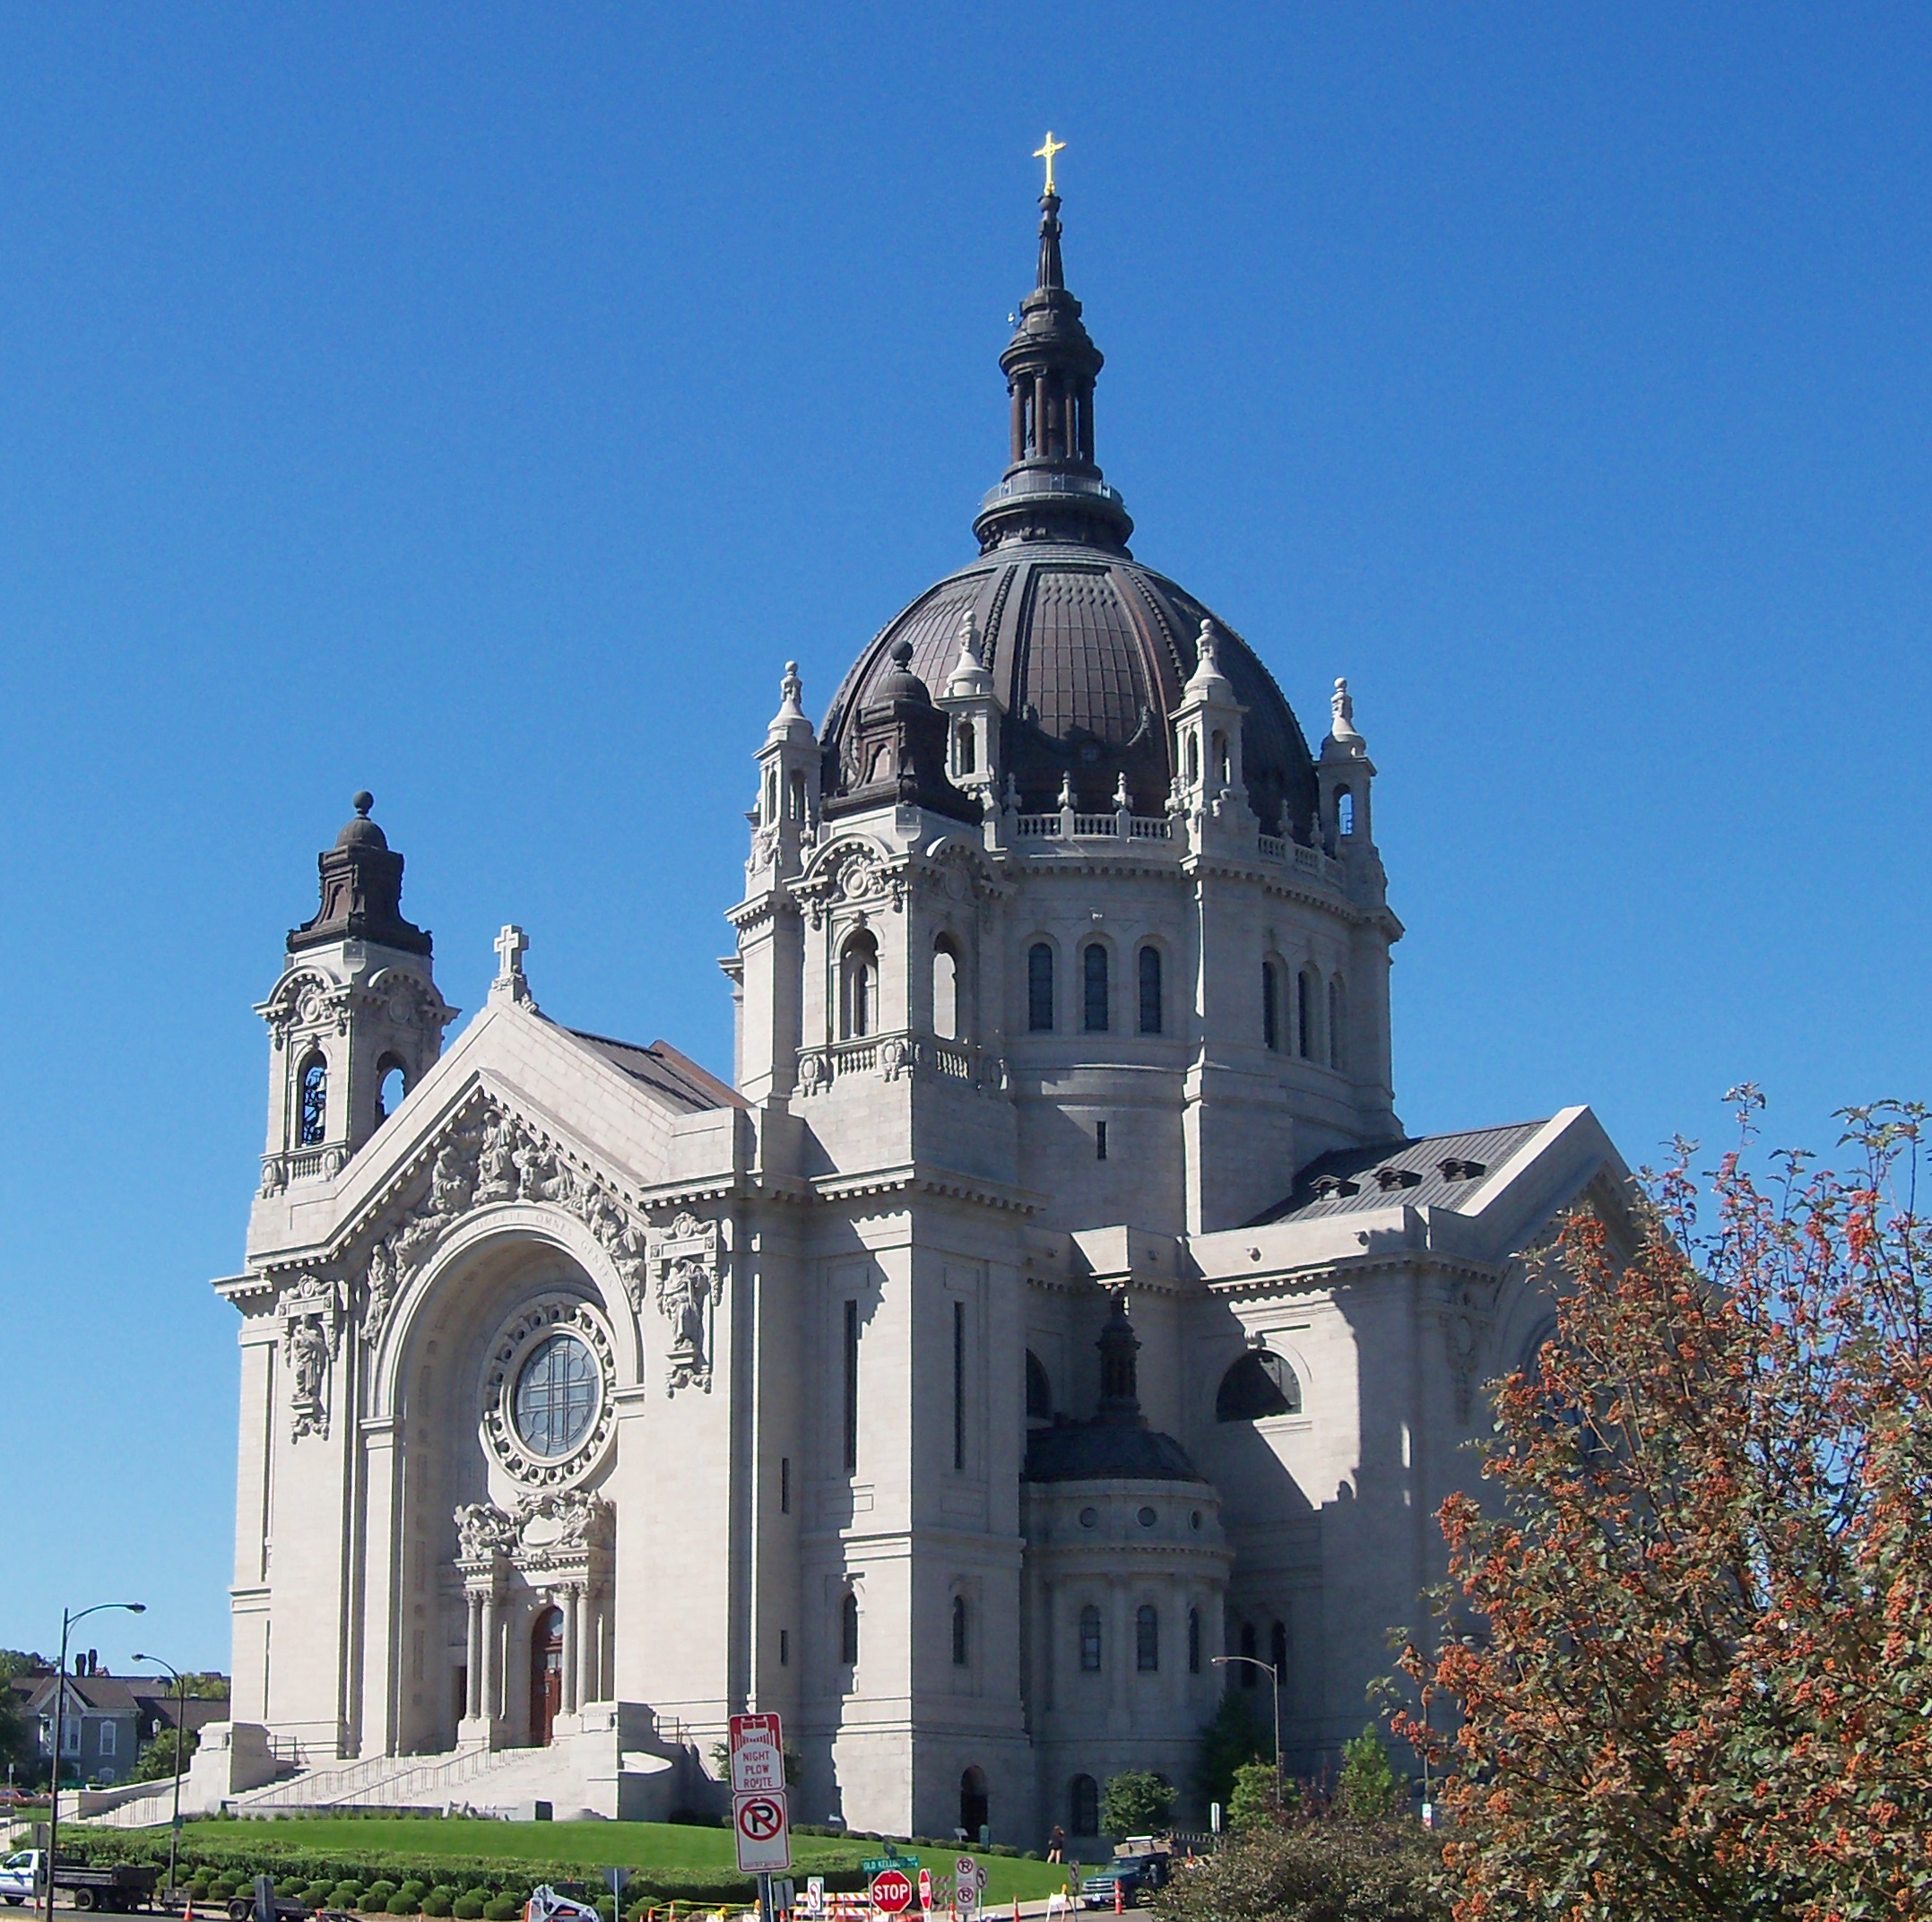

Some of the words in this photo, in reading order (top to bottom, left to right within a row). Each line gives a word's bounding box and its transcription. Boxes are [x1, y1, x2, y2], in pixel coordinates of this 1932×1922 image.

[743, 1751, 770, 1762] NIGHT
[745, 1764, 769, 1775] PLOW
[743, 1777, 773, 1788] ROUTE
[751, 1805, 774, 1833] P
[874, 1883, 908, 1900] STOP
